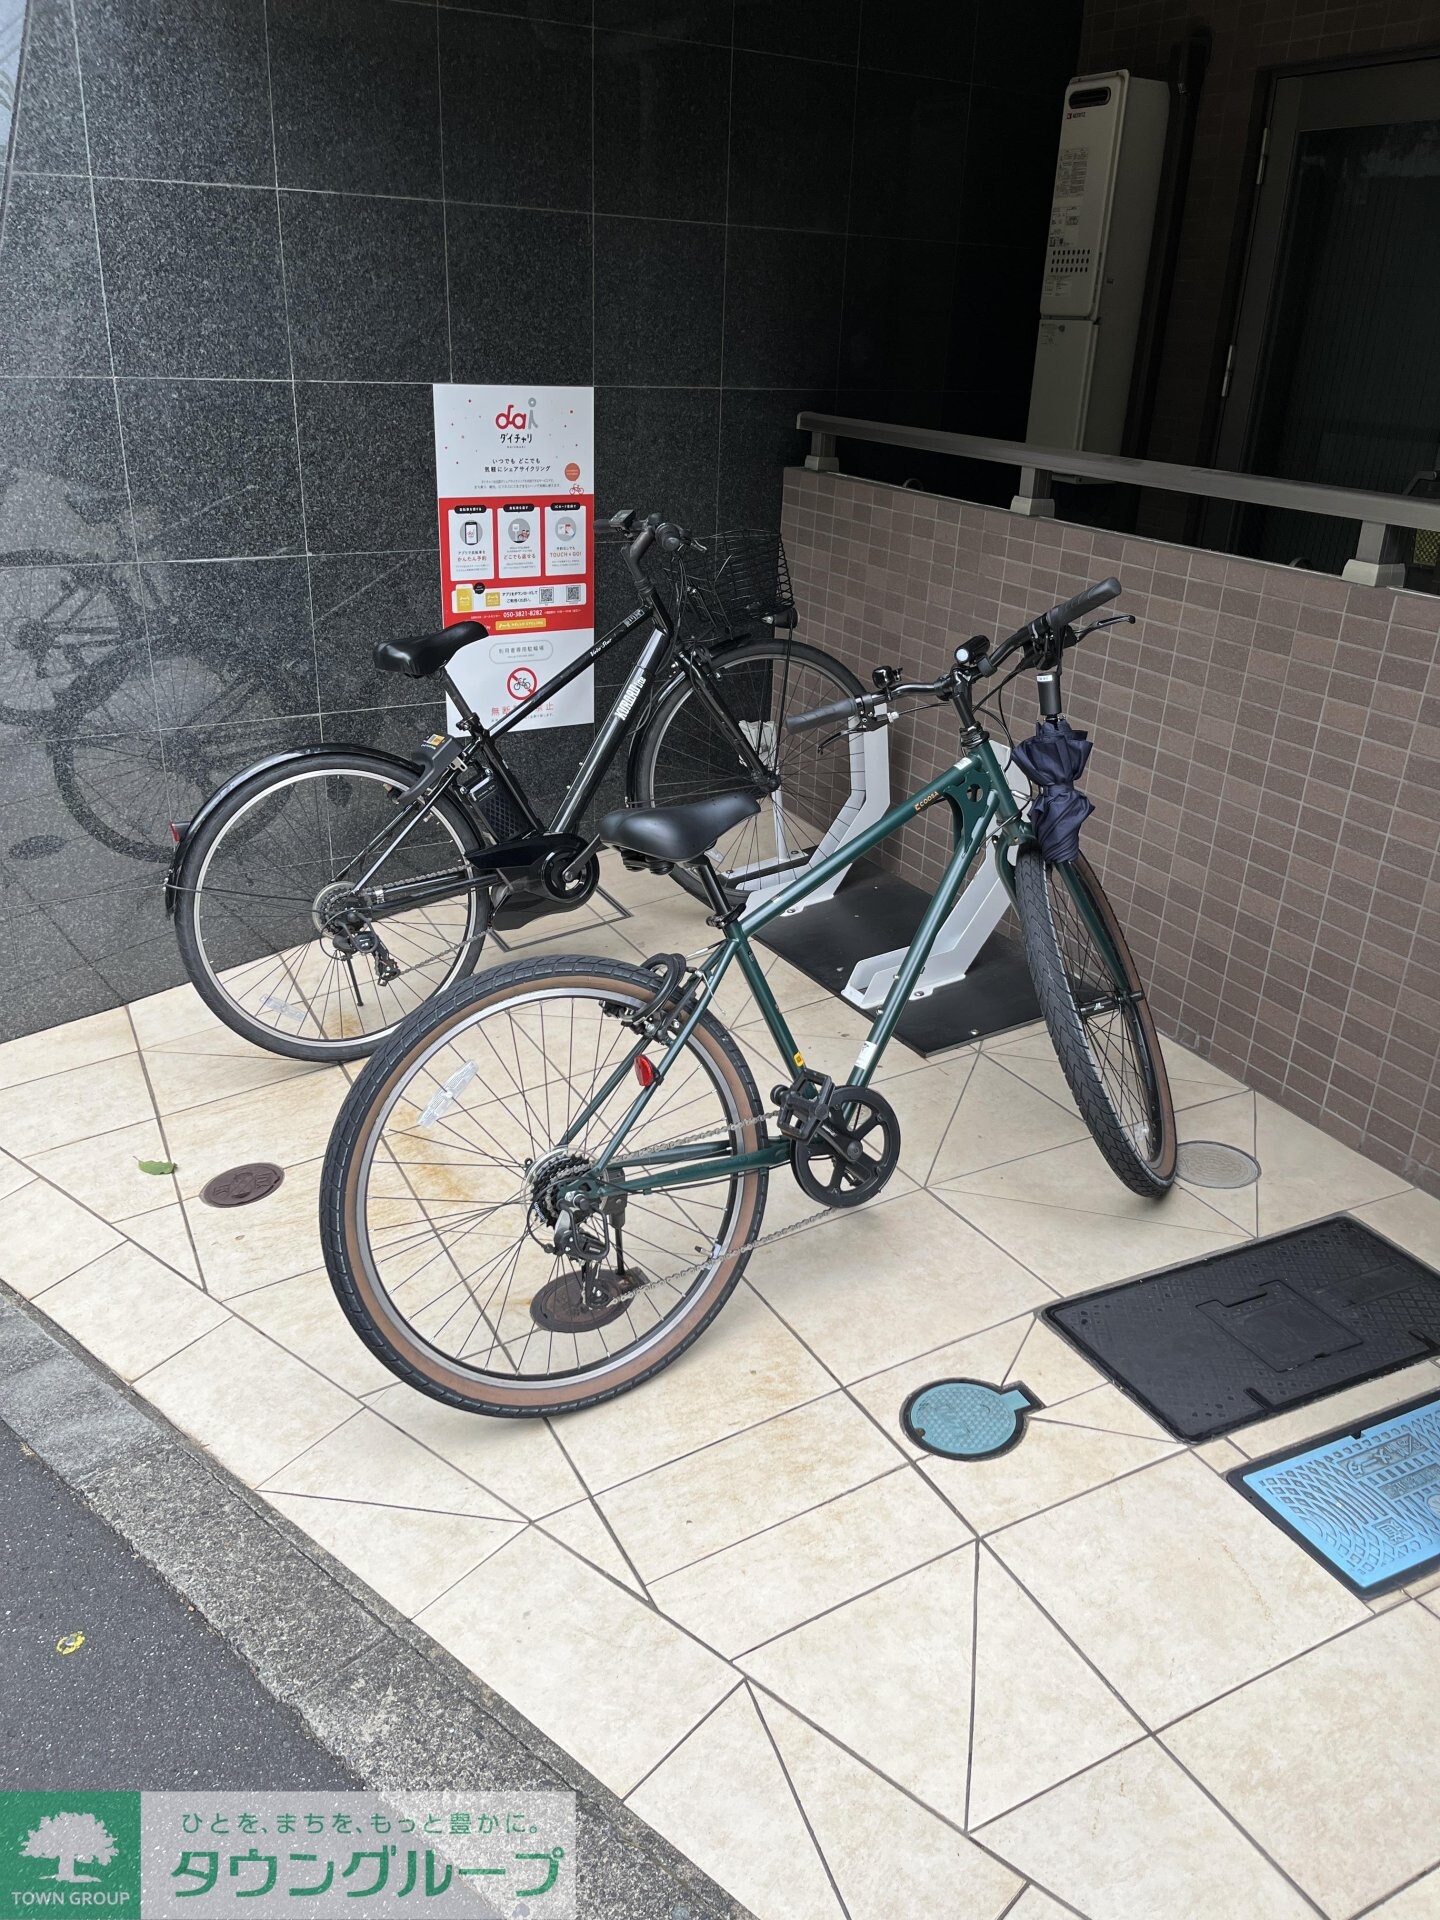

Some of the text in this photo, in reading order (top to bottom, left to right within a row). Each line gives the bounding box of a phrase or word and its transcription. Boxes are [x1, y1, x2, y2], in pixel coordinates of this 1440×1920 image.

[495, 397, 539, 430] dai
[500, 433, 532, 444] ダイチャリ
[484, 465, 551, 473] 気軽にシェアサイクリング
